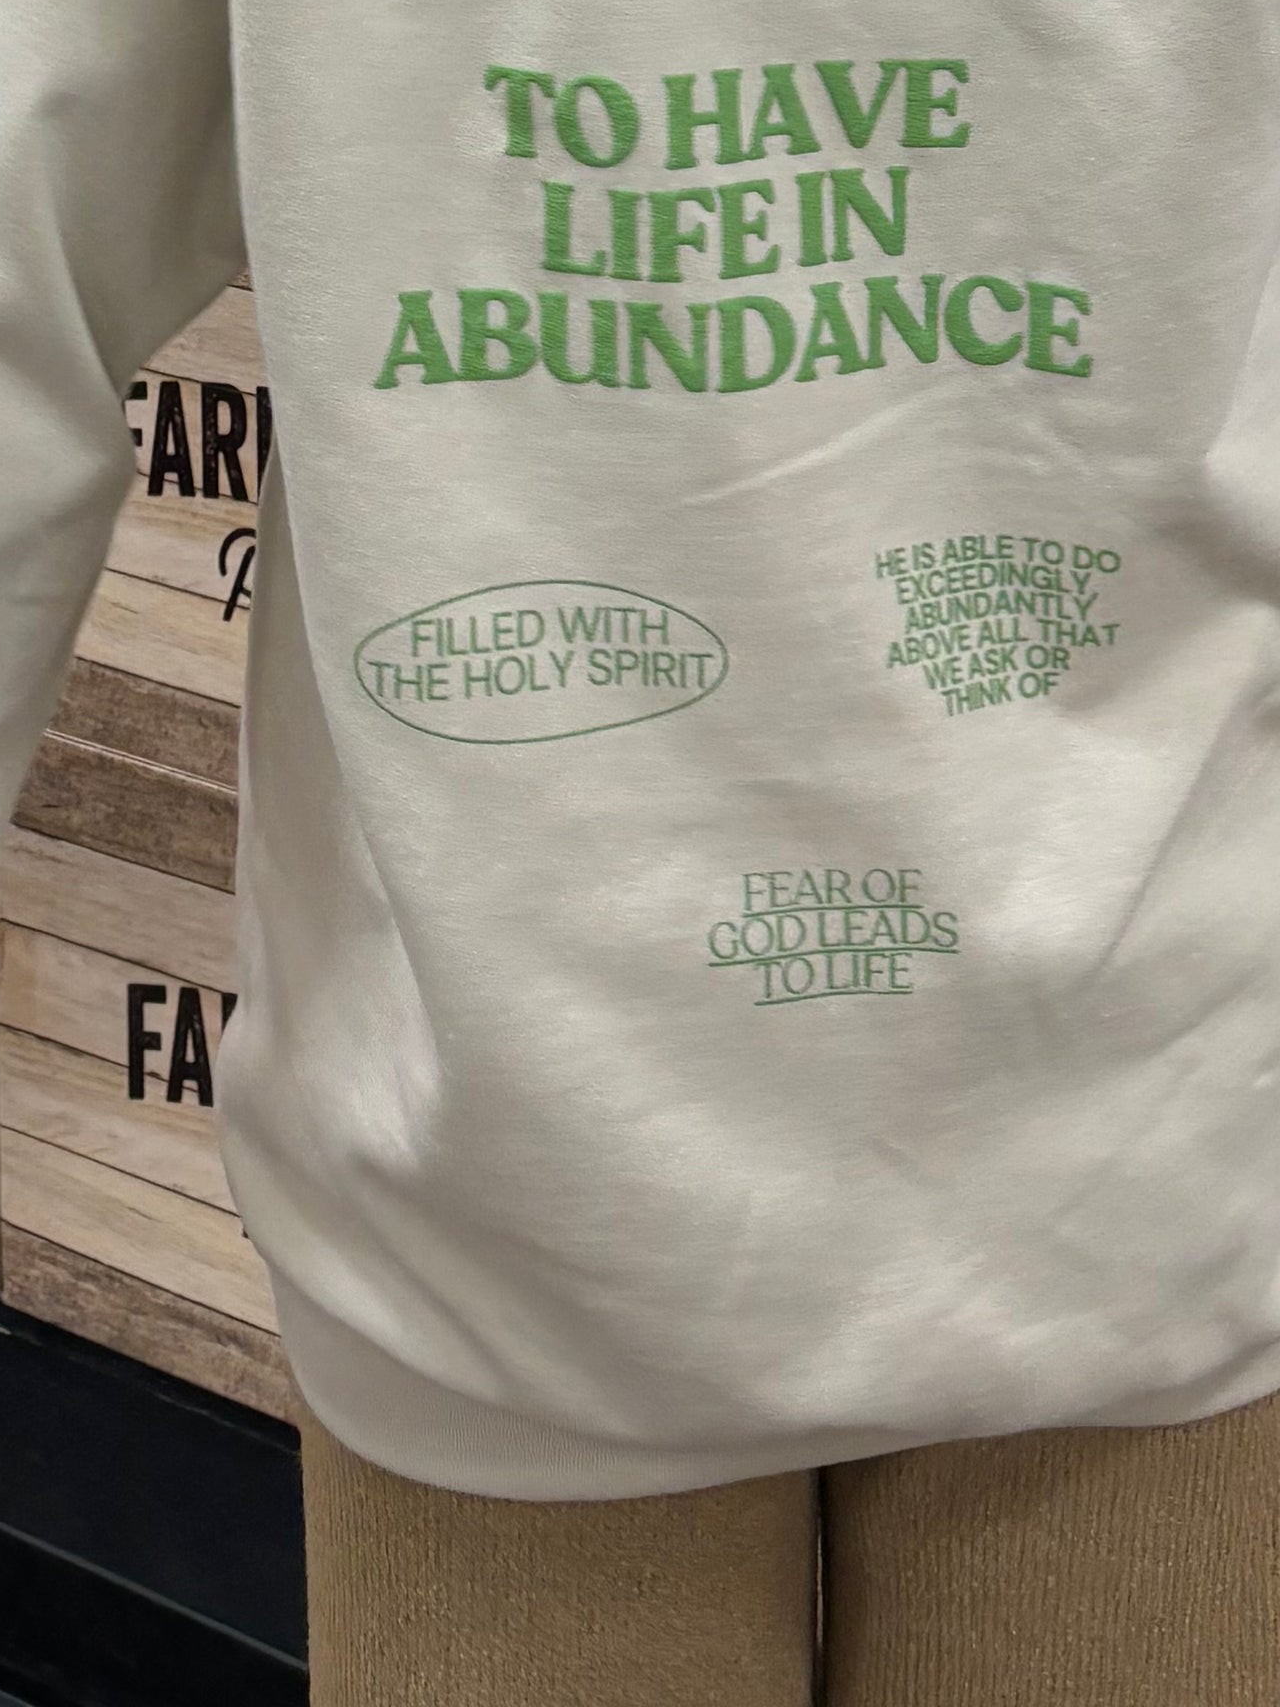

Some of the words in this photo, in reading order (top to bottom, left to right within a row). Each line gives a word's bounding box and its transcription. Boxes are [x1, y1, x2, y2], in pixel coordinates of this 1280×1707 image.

[483, 62, 641, 170] TO
[662, 57, 972, 172] HAVE
[540, 177, 783, 285] LIFE
[795, 165, 911, 269] IN
[373, 272, 1094, 395] ABUNDANCE
[875, 546, 907, 579] HE
[911, 541, 936, 571] IS
[941, 534, 1013, 566] ABLE
[1022, 537, 1065, 566] TO
[1072, 543, 1121, 574] DO
[895, 561, 1092, 605] EXCEEDINGLY
[408, 608, 548, 659] FILLED
[557, 604, 671, 648] WITH
[904, 589, 1100, 635] ABUNDANTLY
[886, 624, 971, 669] ABOVE
[977, 617, 1029, 648] ALL
[1036, 617, 1121, 648] THAT
[922, 656, 964, 691] WE
[969, 645, 1019, 680] ASK
[1025, 644, 1071, 671] OR
[367, 655, 452, 703] THE
[463, 649, 578, 699] HOLY
[586, 649, 717, 690] SPIRIT
[941, 675, 1012, 717] THINK
[1017, 671, 1060, 699] OF
[742, 868, 853, 912] FEAR
[861, 867, 923, 905] OF
[707, 913, 807, 961] GOD
[818, 908, 960, 948] LEADS
[755, 956, 816, 1000] TO
[824, 952, 914, 990] LIFE
[127, 983, 238, 1108] FA
